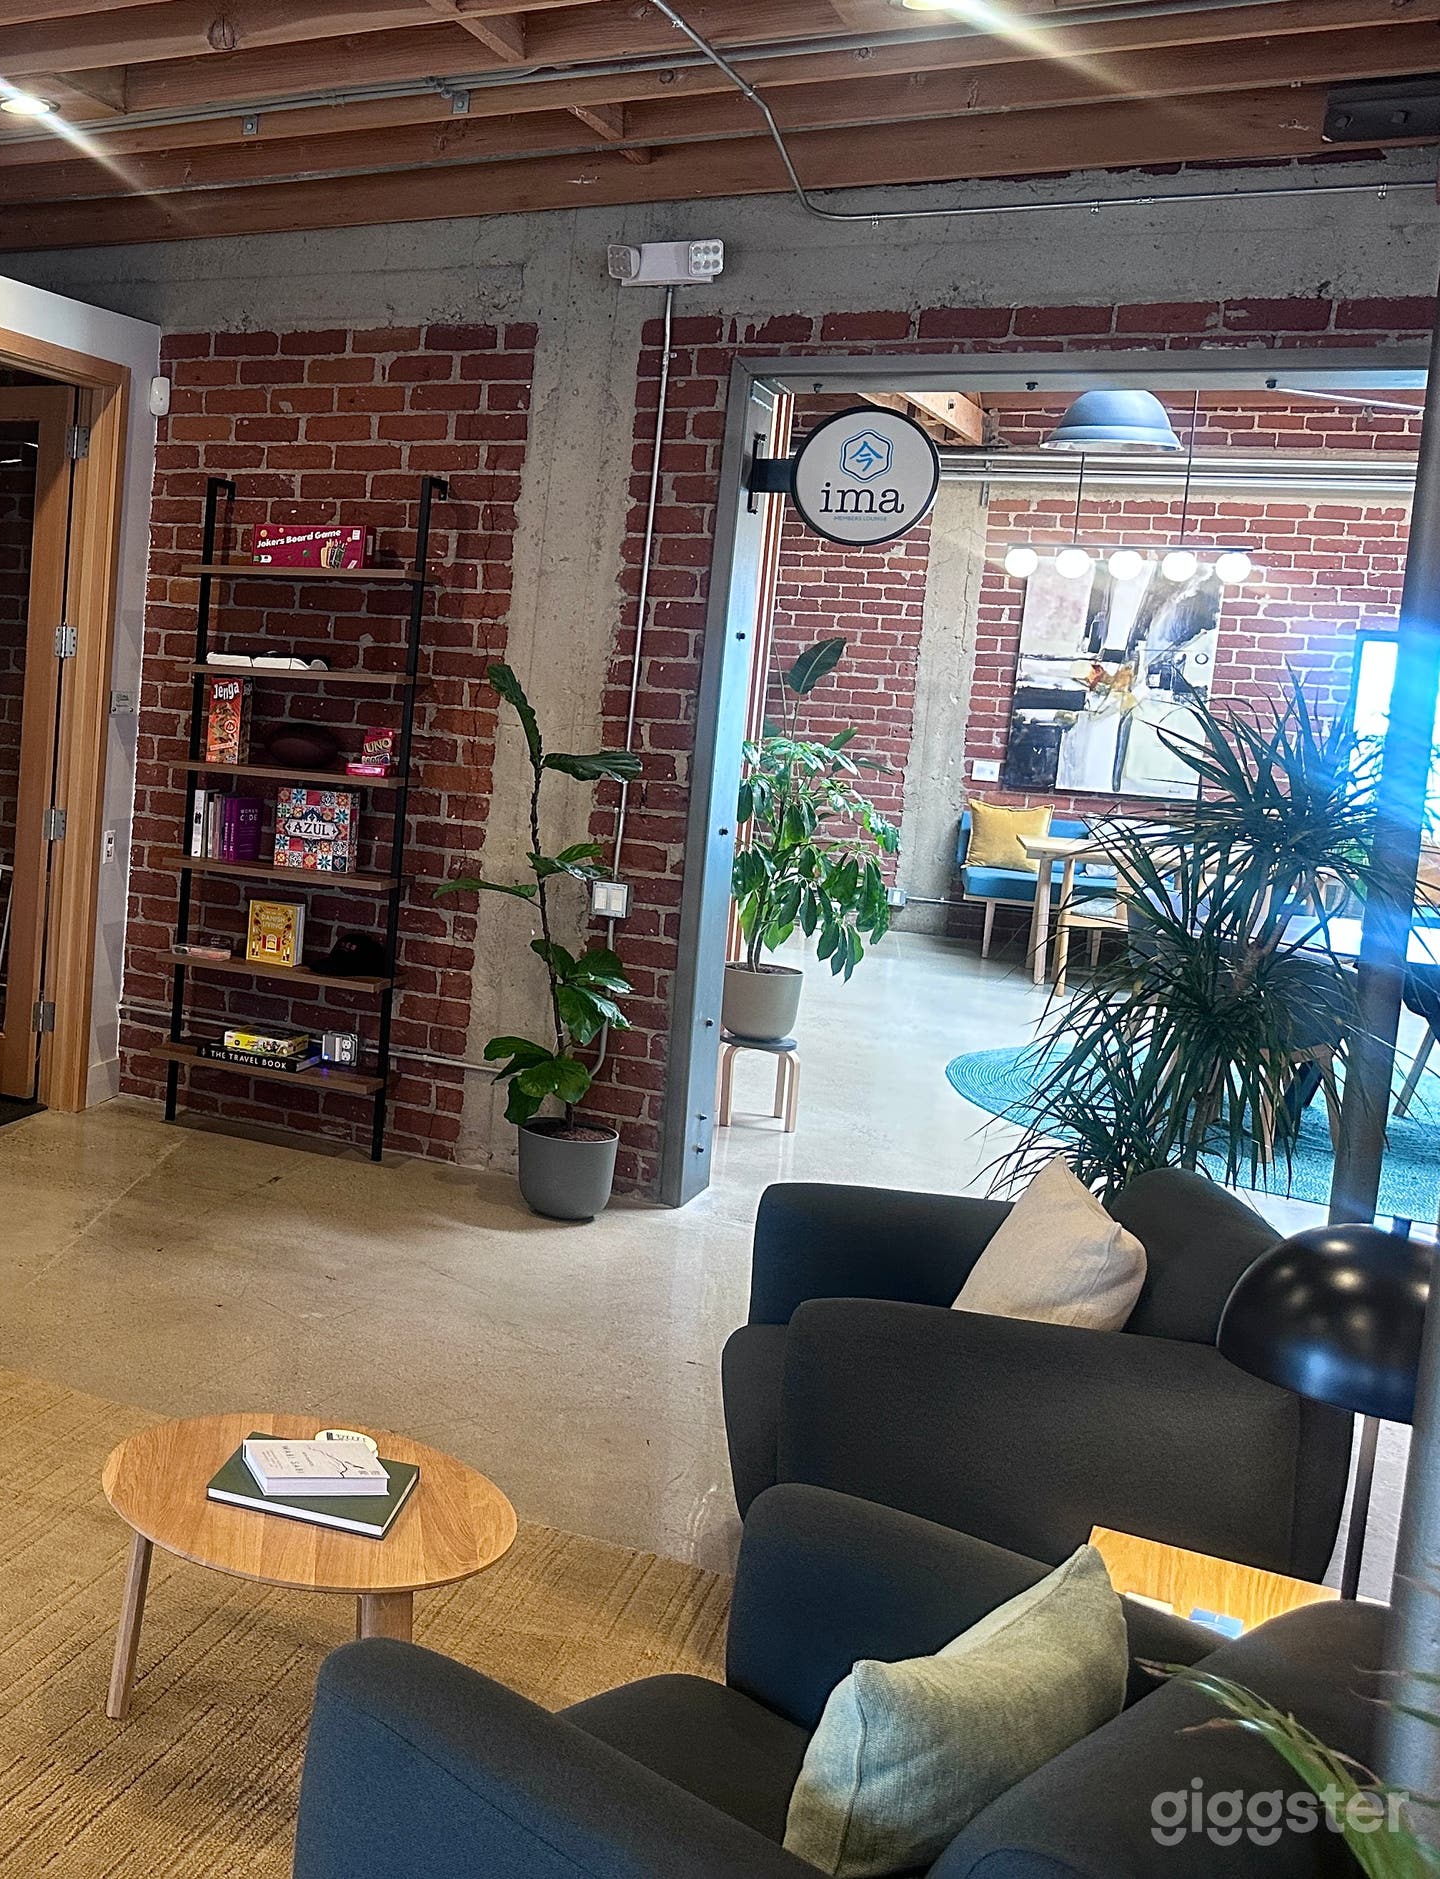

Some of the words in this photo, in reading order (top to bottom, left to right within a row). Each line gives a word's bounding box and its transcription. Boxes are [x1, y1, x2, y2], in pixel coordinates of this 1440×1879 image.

[819, 482, 905, 514] ima
[257, 537, 285, 549] Jokers
[286, 532, 314, 544] Board
[315, 529, 342, 540] Game
[213, 681, 240, 700] Jenga
[364, 738, 392, 754] UNO
[293, 822, 330, 836] AZUL
[210, 1050, 226, 1060] THE
[228, 1053, 259, 1065] TRAVEL
[262, 1059, 287, 1070] BOOK
